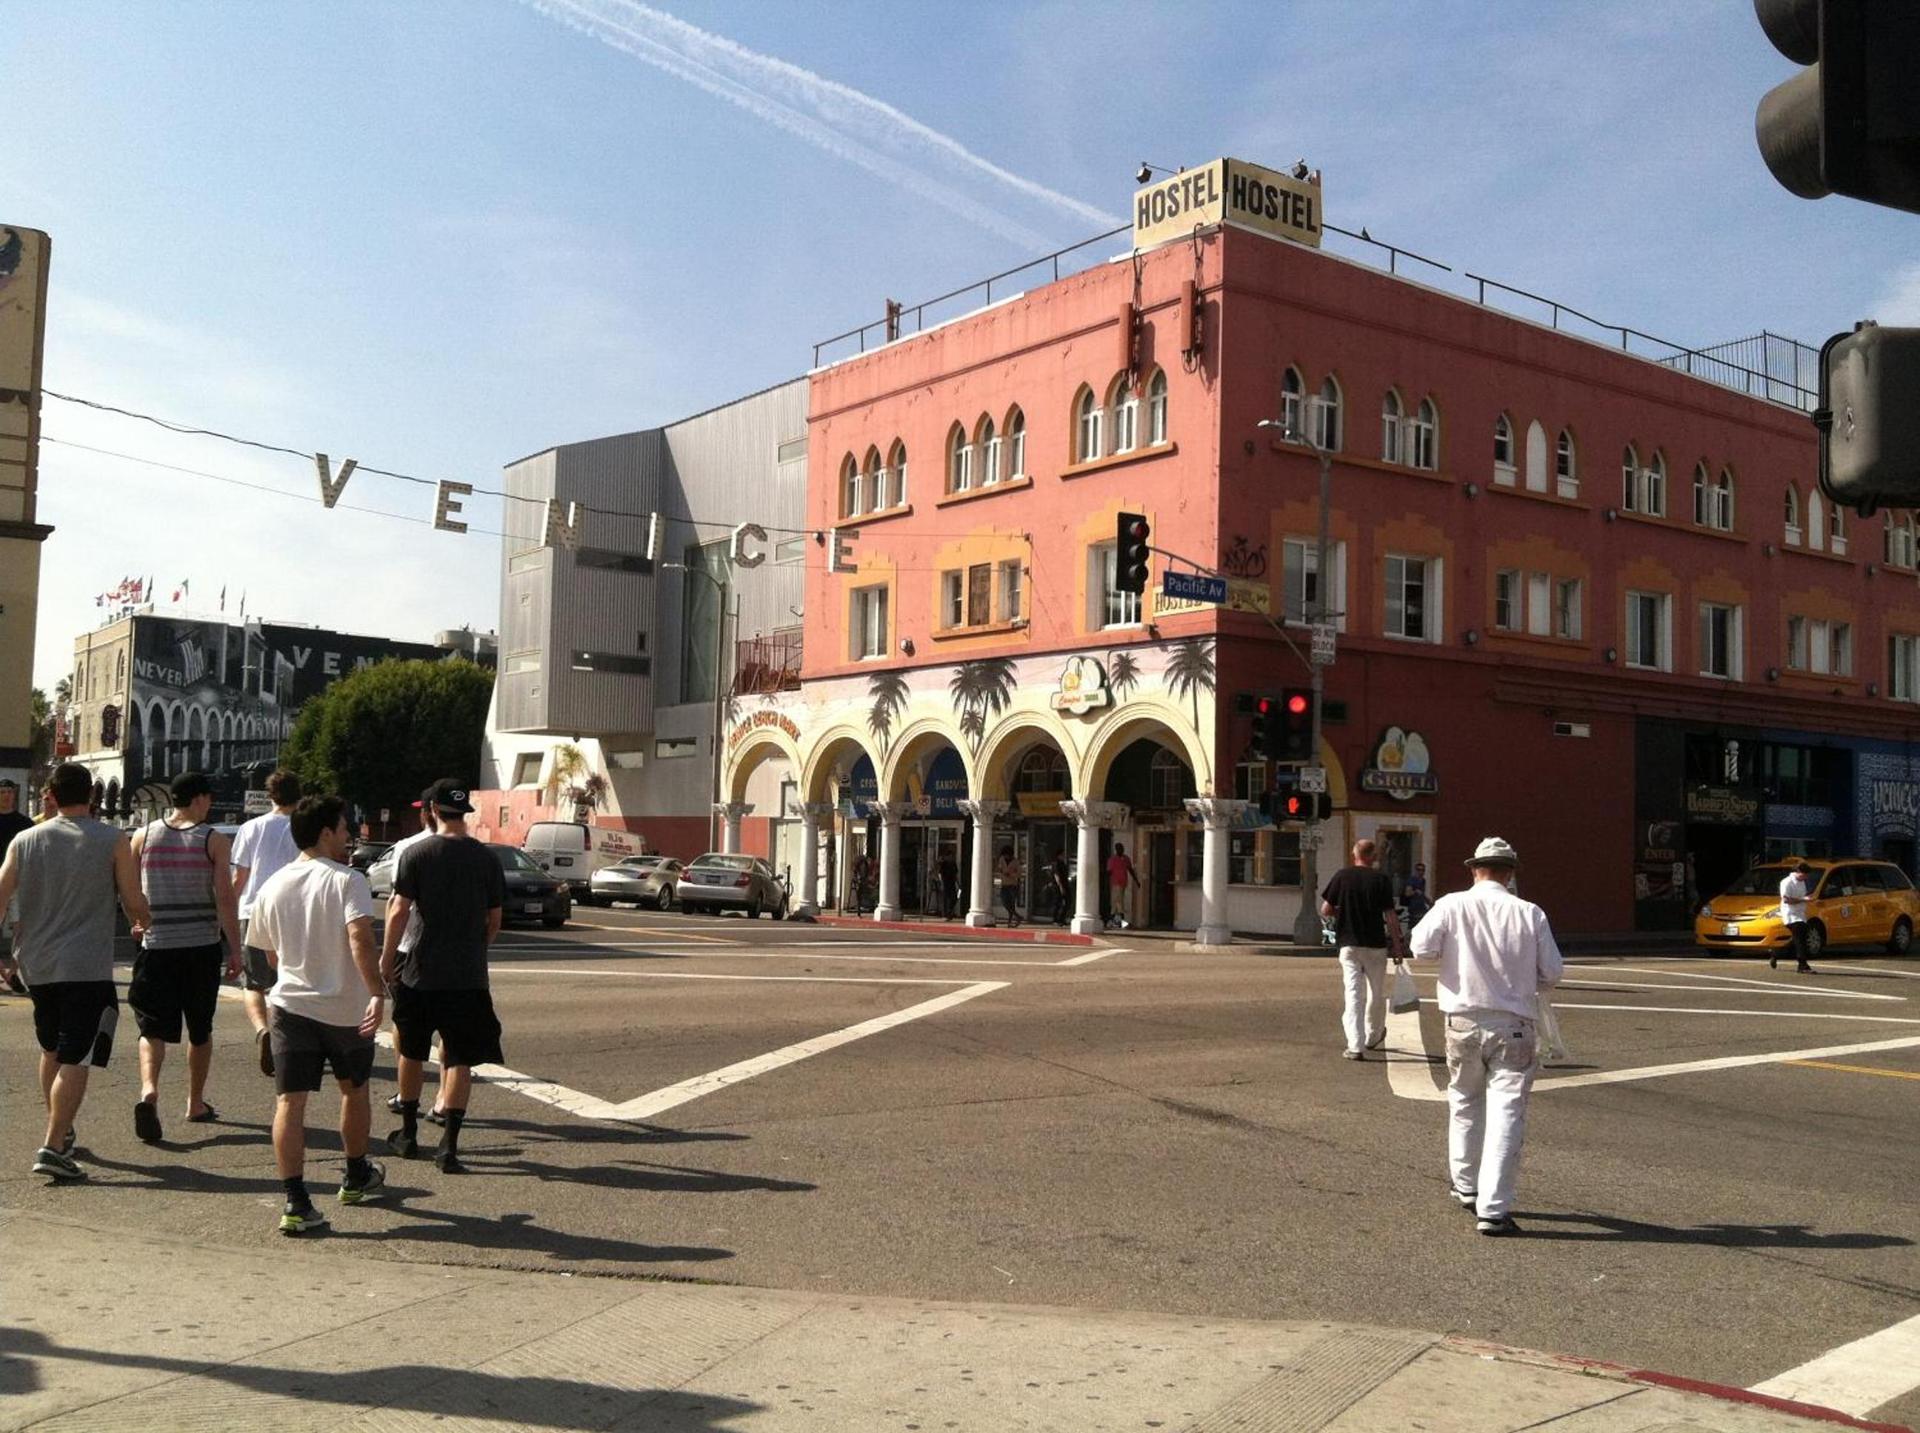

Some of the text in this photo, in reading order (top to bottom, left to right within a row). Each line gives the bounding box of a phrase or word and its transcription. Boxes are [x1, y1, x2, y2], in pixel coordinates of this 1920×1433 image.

[1137, 168, 1219, 230] HOSTEL
[1233, 173, 1317, 233] HOSTEL
[315, 452, 860, 574] VENICE
[1168, 577, 1223, 597] Pacific Av
[134, 658, 184, 687] NEVER
